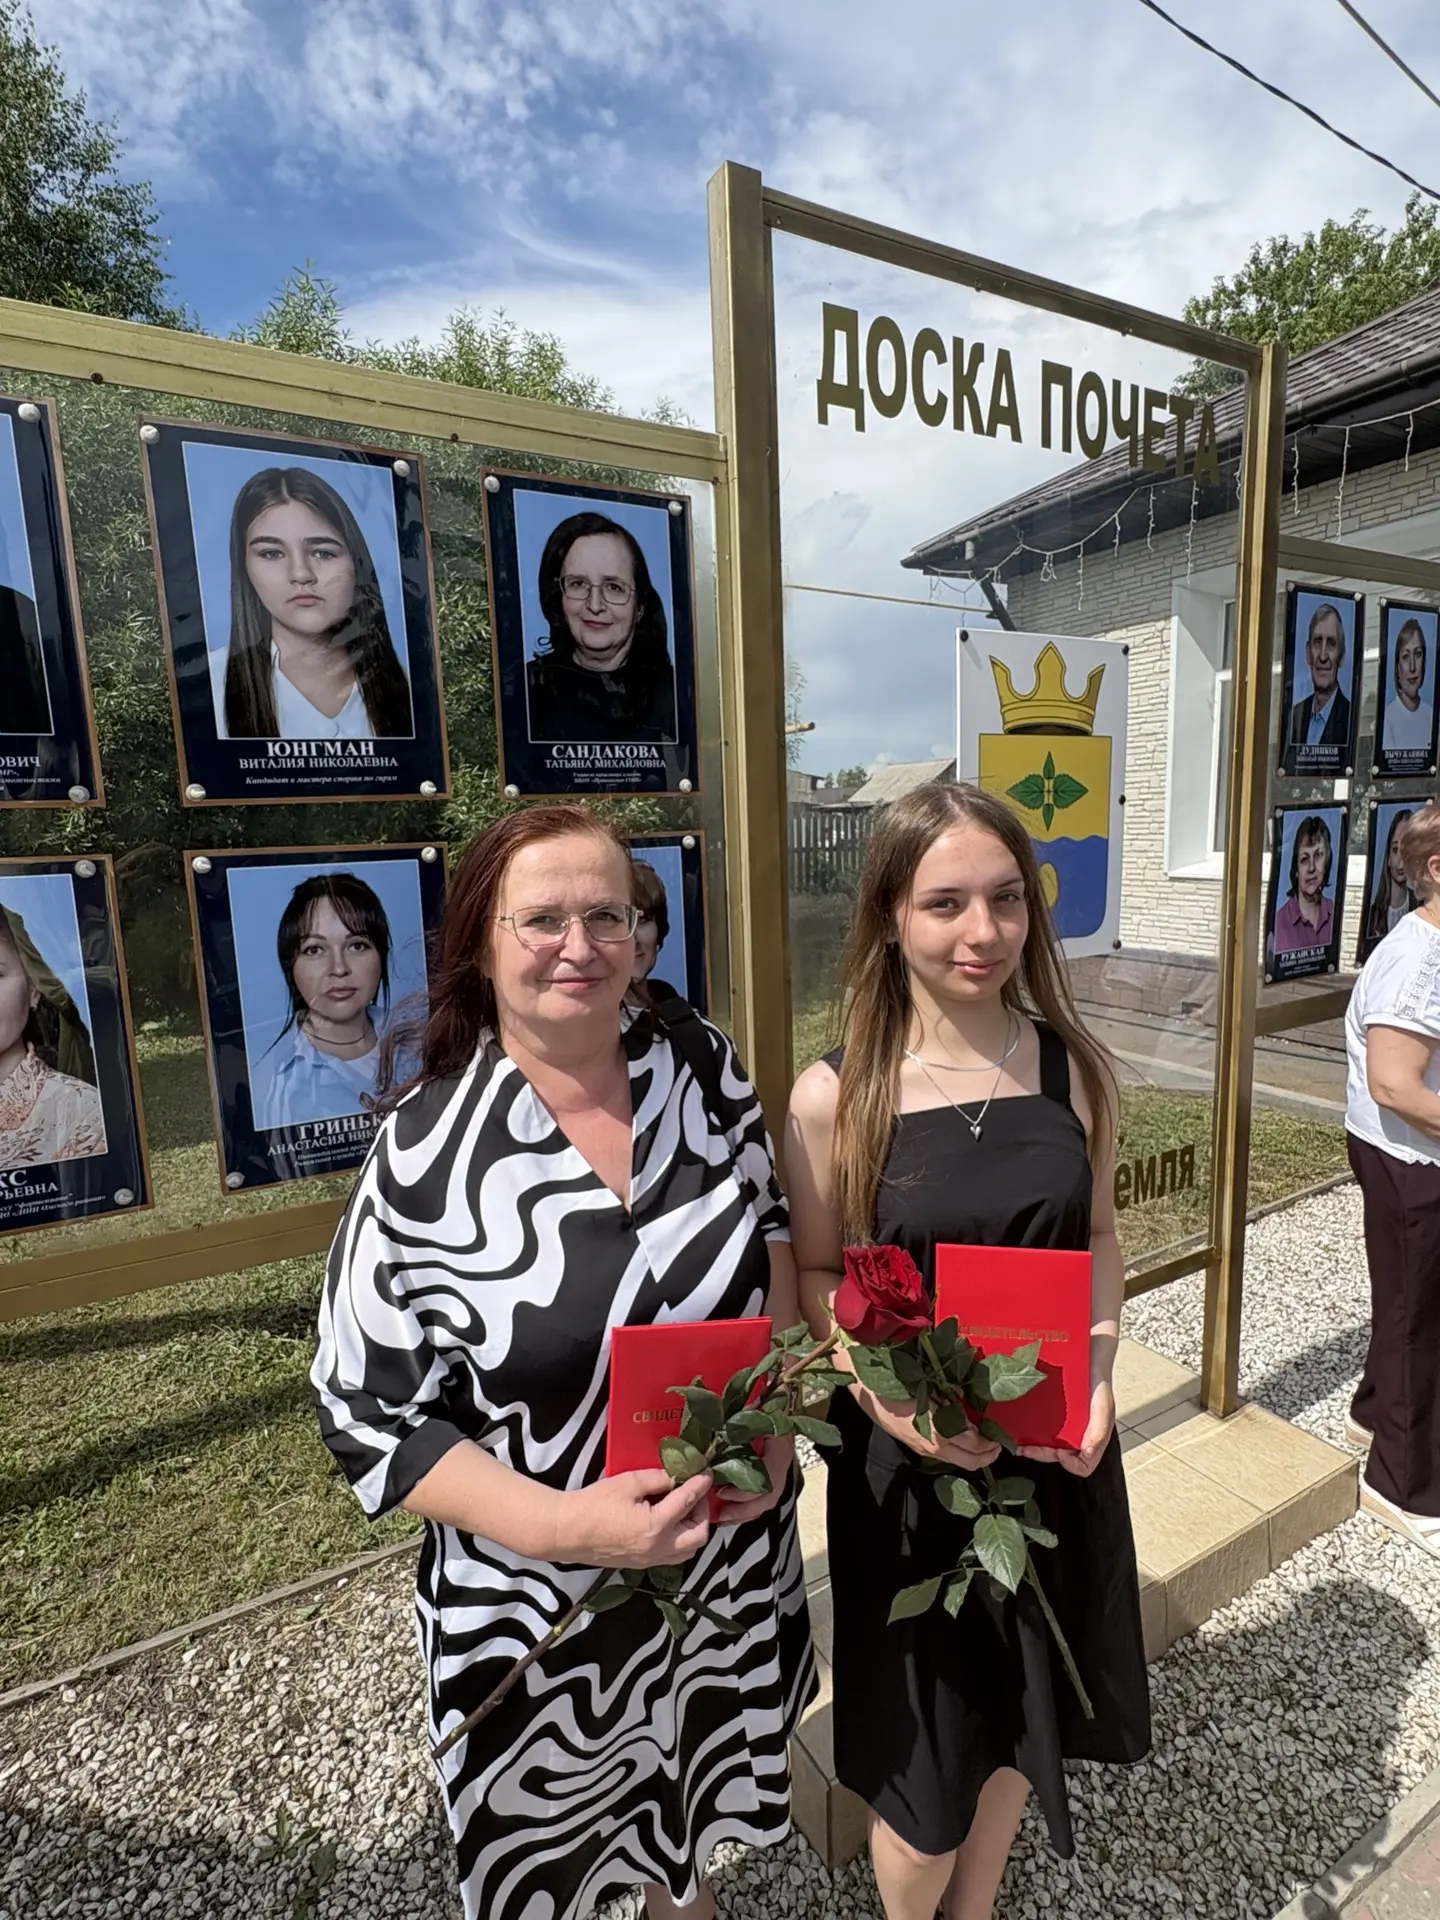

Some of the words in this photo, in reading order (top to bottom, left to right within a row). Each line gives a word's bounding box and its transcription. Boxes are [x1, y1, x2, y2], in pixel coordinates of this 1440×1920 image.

[816, 301, 1022, 443] ДОСКА
[1040, 360, 1220, 487] ПОЧЕТА
[265, 741, 376, 757] ЮНГМАН
[551, 744, 659, 759] САНДАКОВА
[239, 758, 305, 769] ВИТАЛИЯ
[309, 757, 398, 768] НИКОЛАЕВНА
[544, 759, 592, 769] ТАТЬЯНА
[595, 758, 667, 769] МИХАЙЛОВНА
[245, 776, 289, 785] Кандидат
[296, 776, 332, 785] мастера
[333, 775, 362, 784] спорта
[299, 1112, 390, 1140] ГРИНЬК
[267, 1134, 345, 1157] АНАСТАСИЯ
